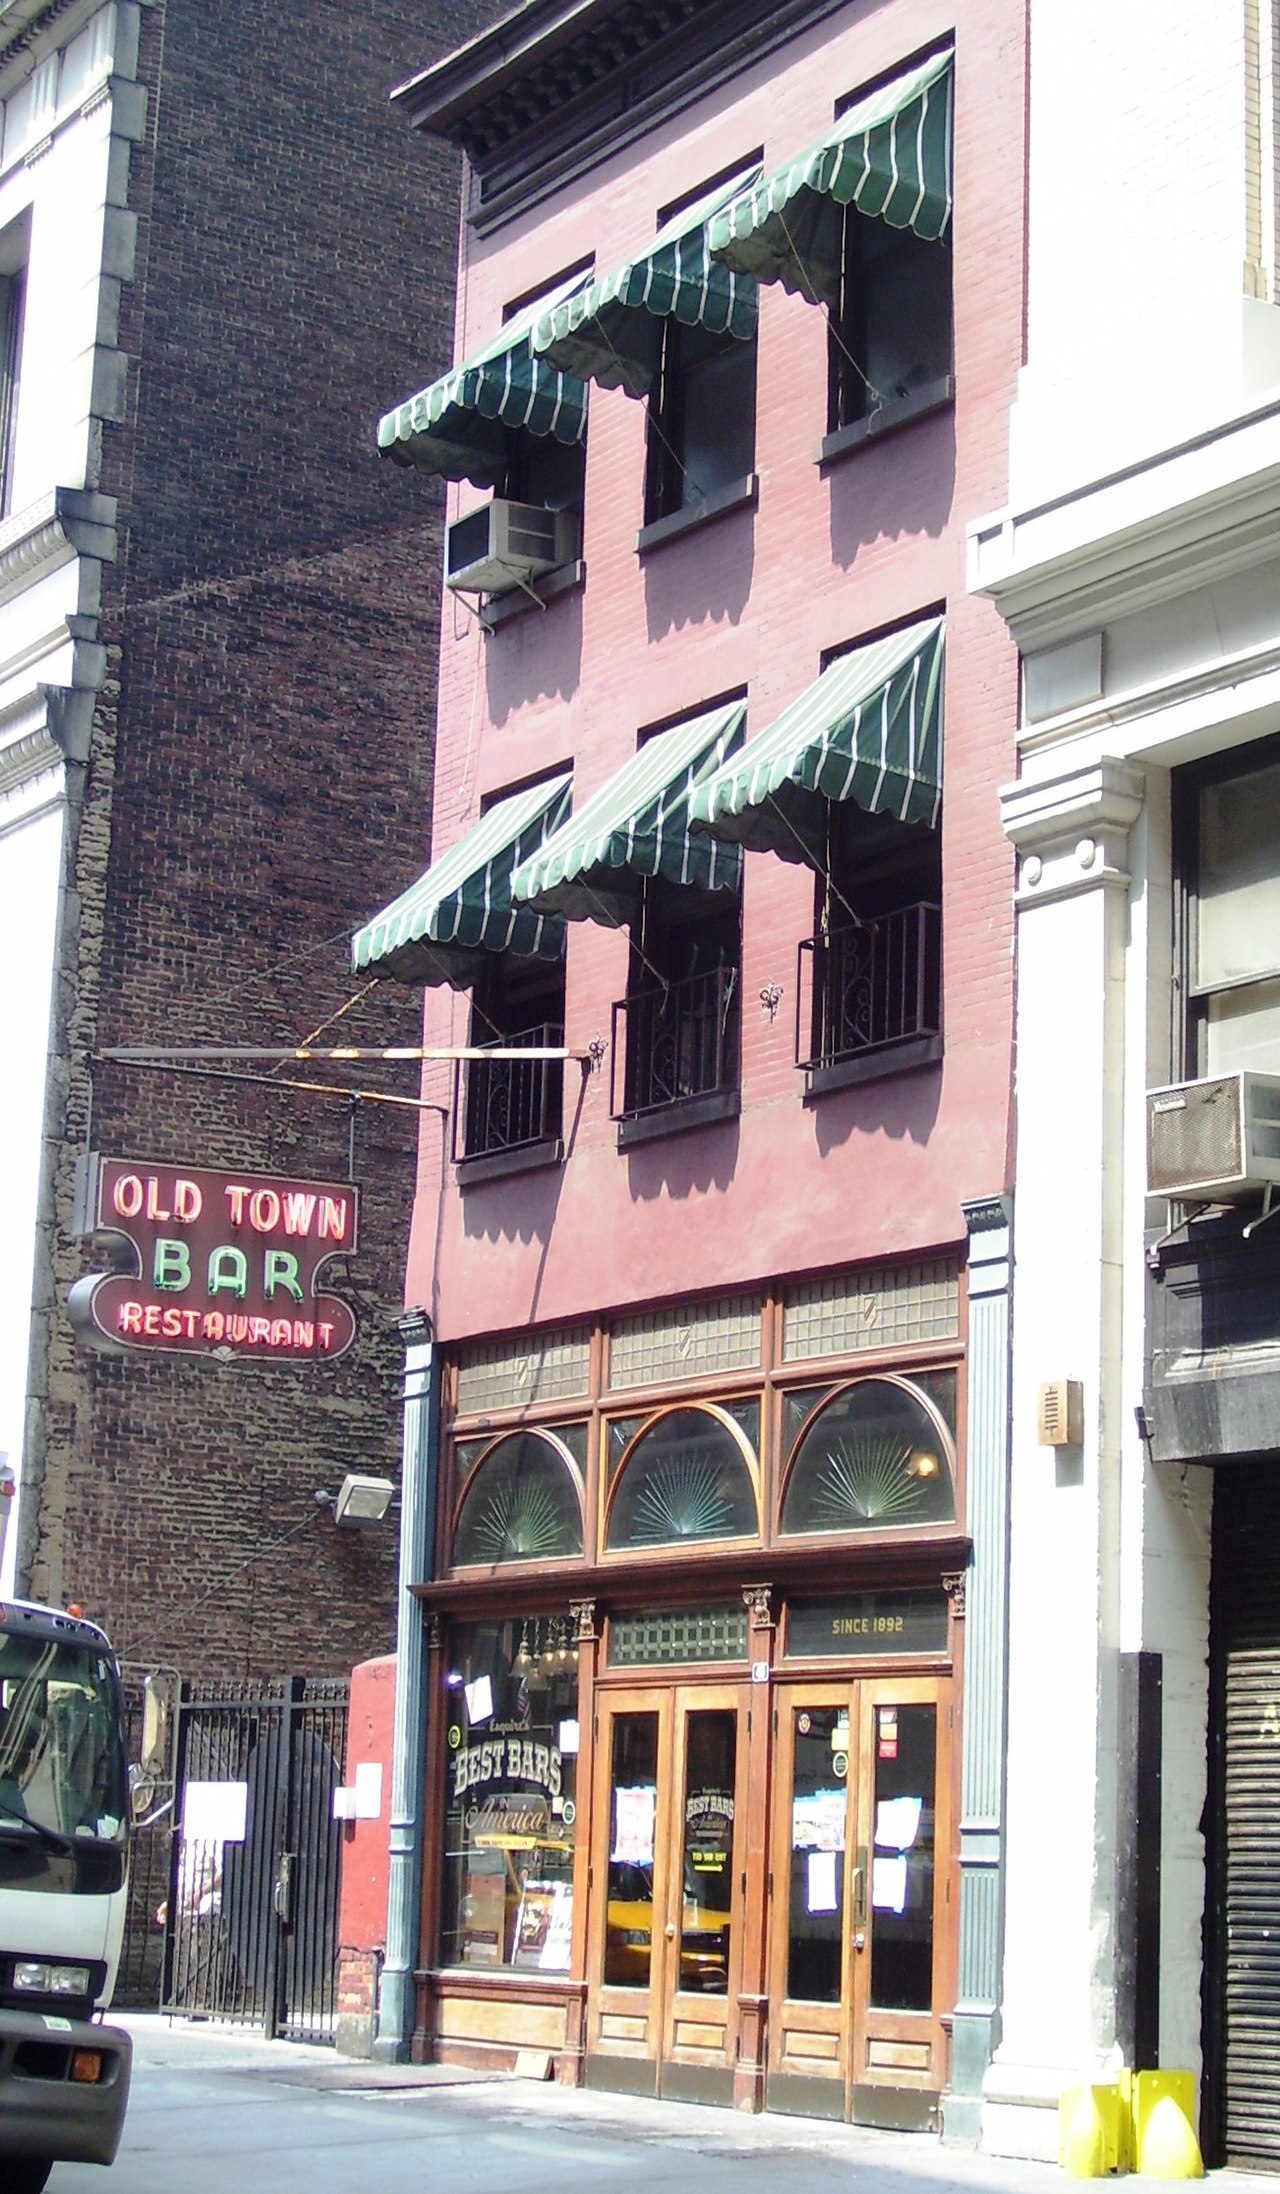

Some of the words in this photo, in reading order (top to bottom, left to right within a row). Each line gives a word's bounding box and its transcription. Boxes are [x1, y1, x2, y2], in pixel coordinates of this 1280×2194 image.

[113, 1174, 203, 1224] OLD
[224, 1184, 347, 1240] TOWN
[153, 1238, 304, 1303] BAR
[119, 1302, 334, 1348] RESTAURANT
[831, 1618, 869, 1634] SINCE
[873, 1616, 904, 1633] 1892
[454, 1739, 505, 1797] BEST
[507, 1739, 562, 1796] BARS
[465, 1797, 544, 1830] America
[686, 1795, 710, 1822] BEST
